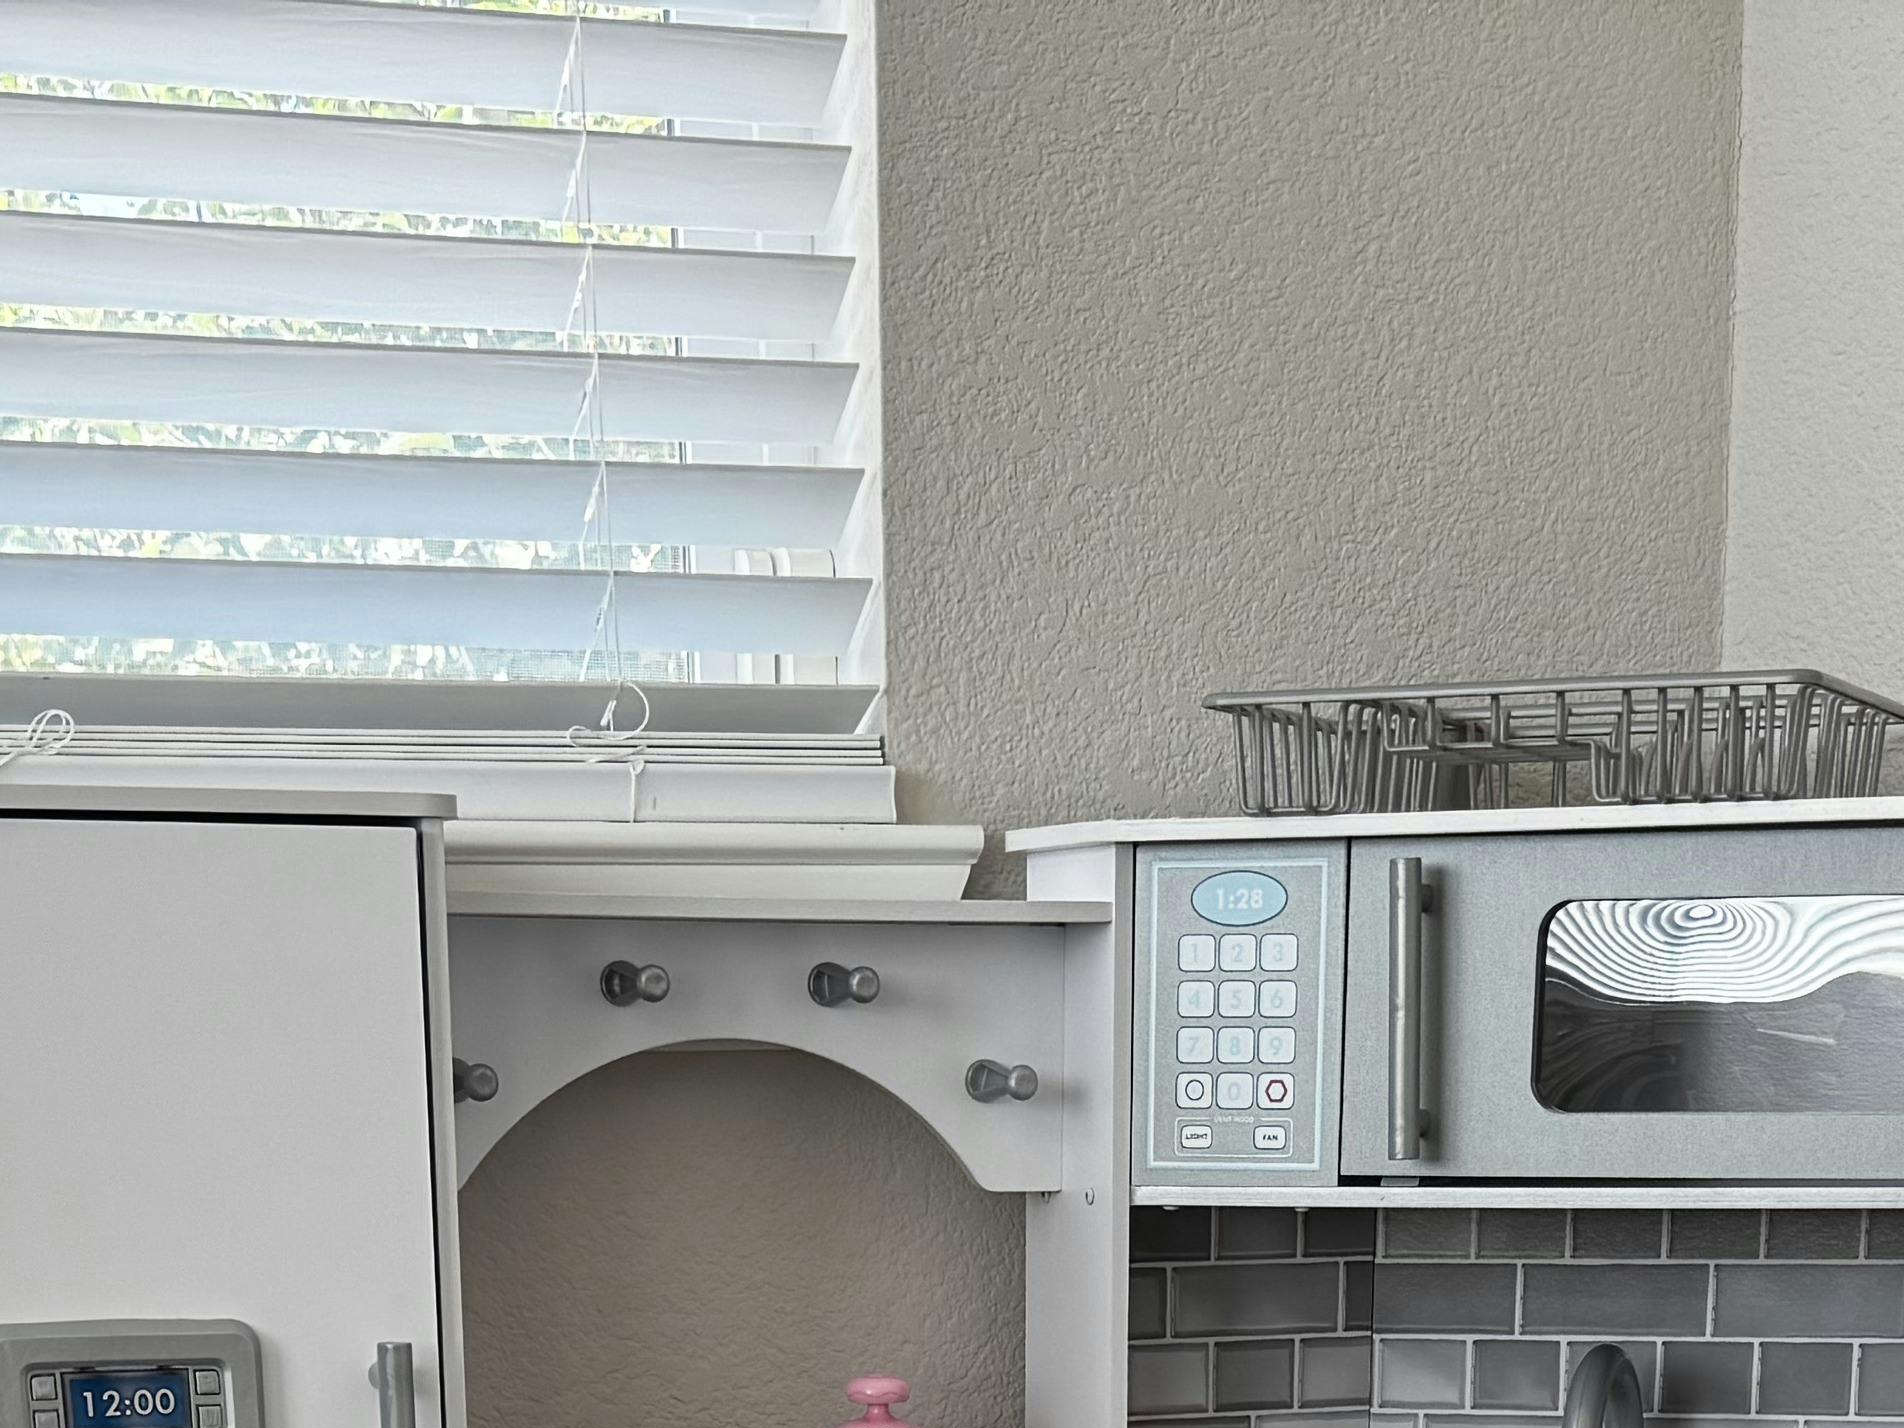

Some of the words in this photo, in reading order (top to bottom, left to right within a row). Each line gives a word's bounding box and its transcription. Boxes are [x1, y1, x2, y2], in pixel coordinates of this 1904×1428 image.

[1215, 887, 1264, 911] 1:28
[1231, 942, 1244, 962] 2
[1272, 942, 1284, 962] 3
[1230, 989, 1242, 1009] 5
[1270, 989, 1283, 1009] 6
[1229, 1036, 1242, 1056] 8
[1270, 1036, 1284, 1055] 9
[82, 1388, 175, 1418] 12:00
